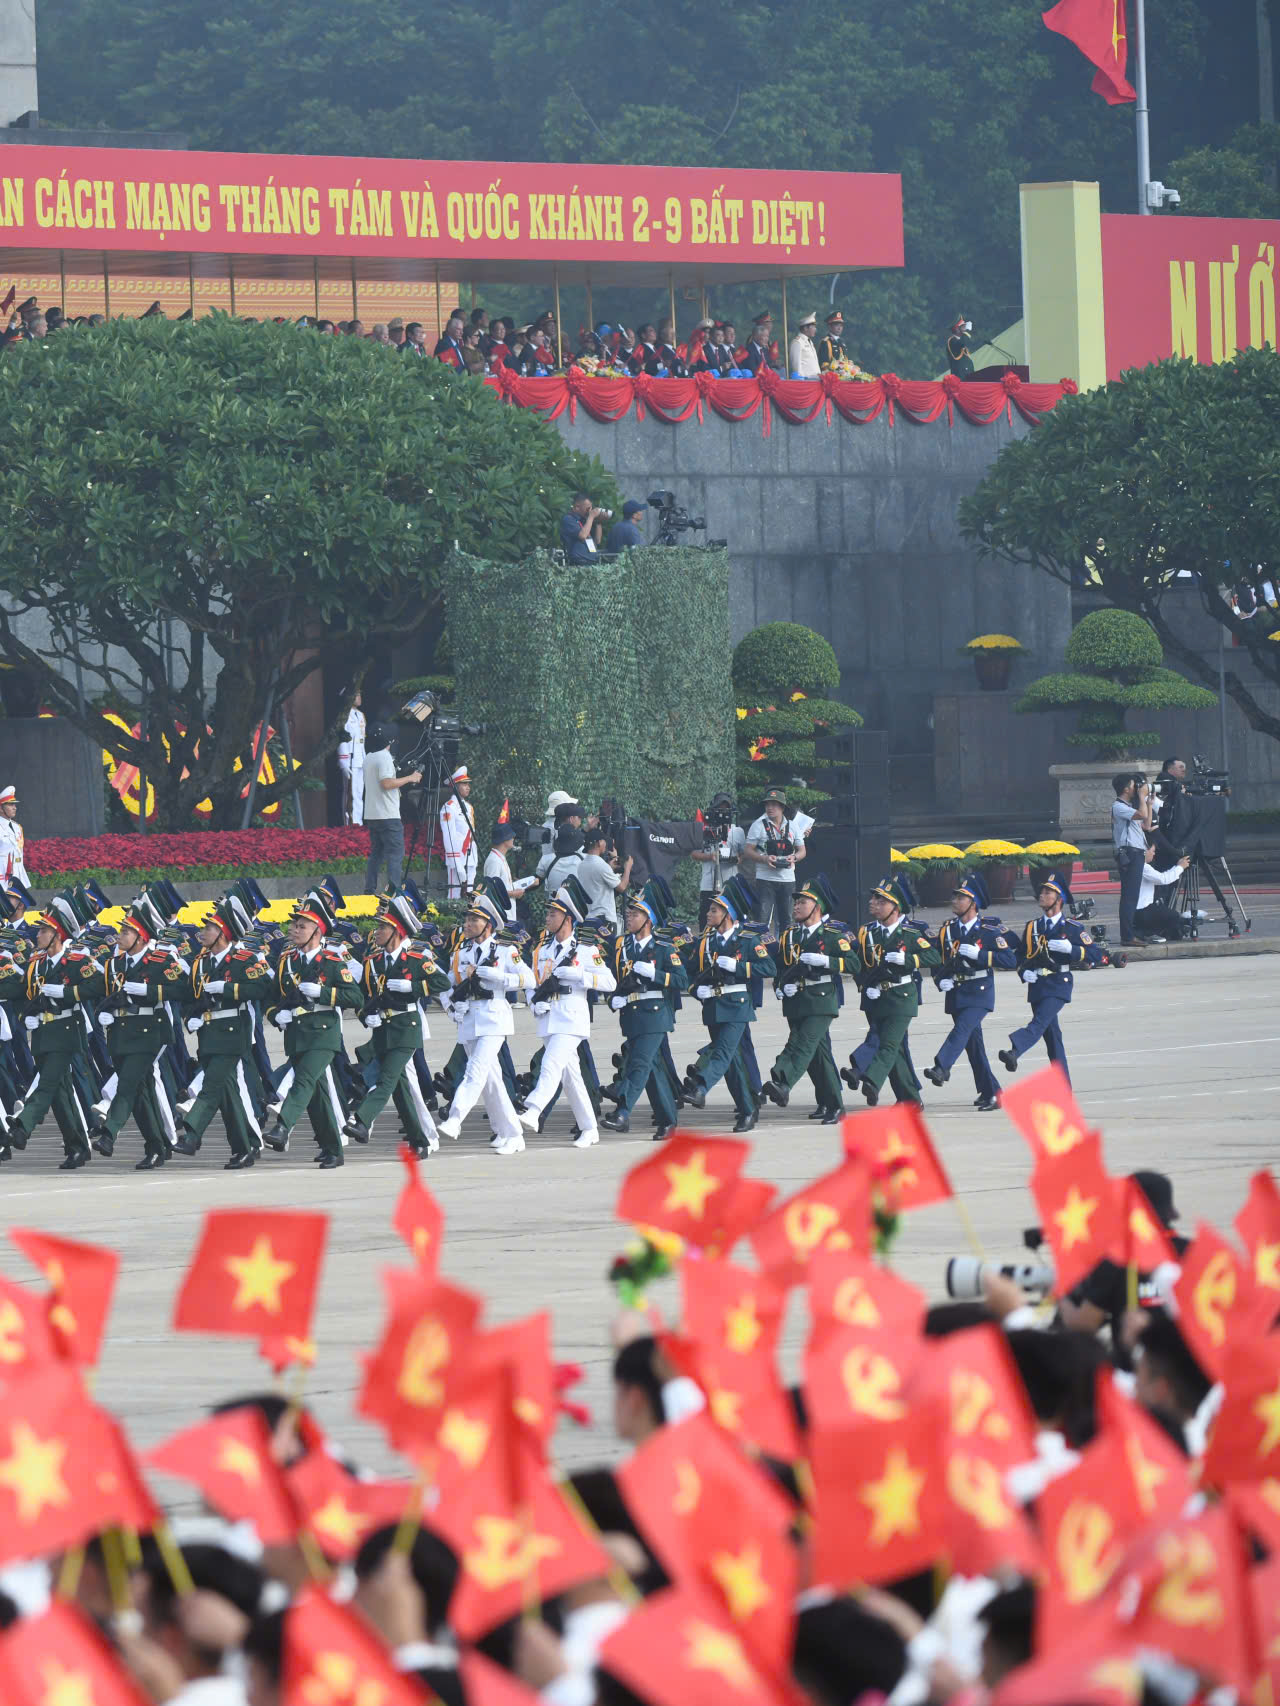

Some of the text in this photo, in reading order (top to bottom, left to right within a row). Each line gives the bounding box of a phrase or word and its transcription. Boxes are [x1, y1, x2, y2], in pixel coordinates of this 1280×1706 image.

[34, 169, 117, 229] CÁCH
[124, 182, 212, 240] MẠNG
[219, 176, 321, 236] THÁNG
[327, 178, 394, 237] TÁM
[399, 181, 440, 239] VÀ
[446, 179, 521, 242] QUỐC
[528, 185, 624, 242] KHÁNH
[632, 196, 682, 244] 2-9
[689, 185, 744, 245] BẤT
[751, 191, 826, 255] DIỆT!
[649, 833, 675, 844] Canon
